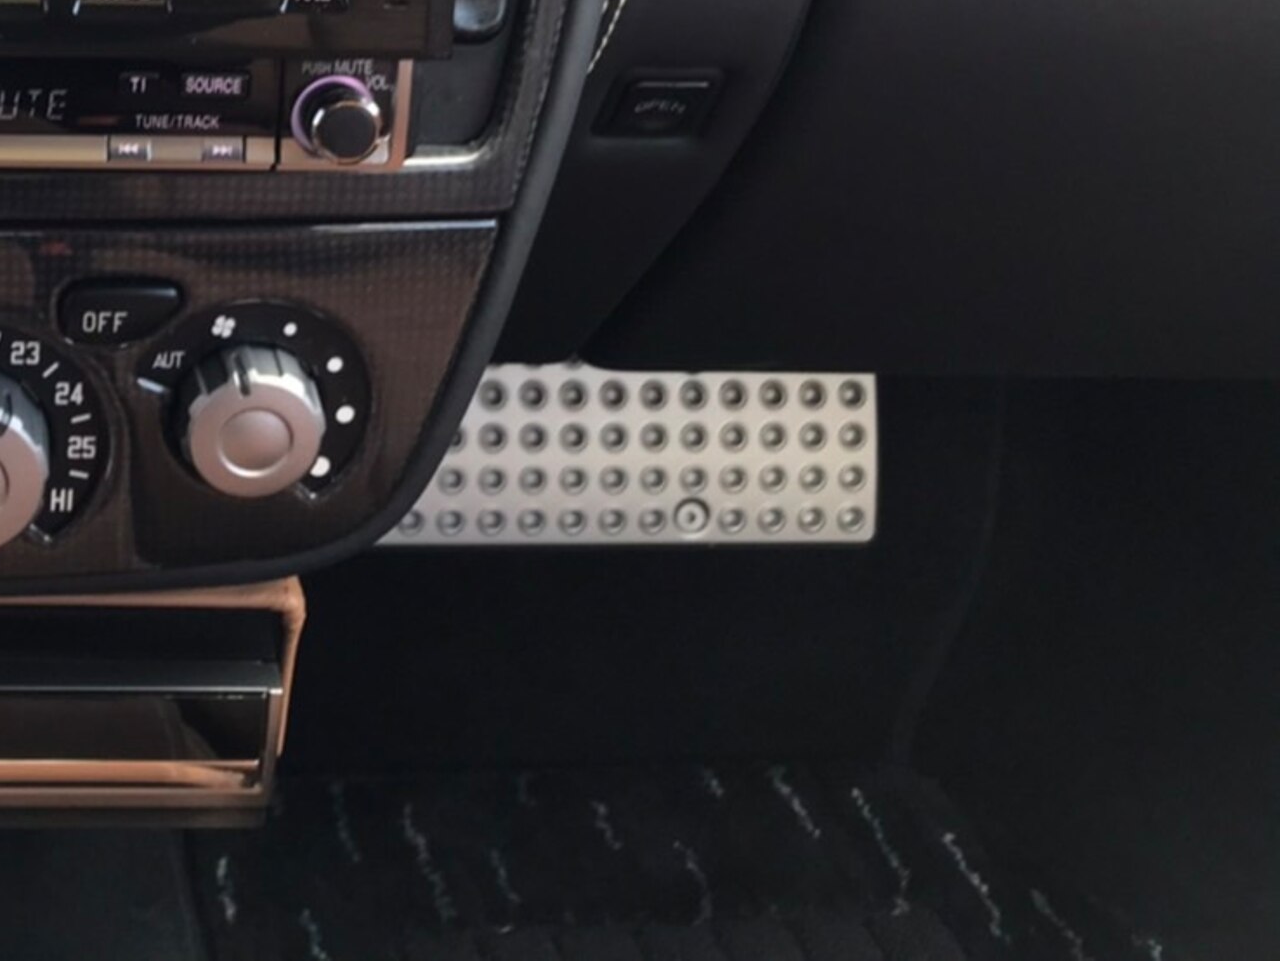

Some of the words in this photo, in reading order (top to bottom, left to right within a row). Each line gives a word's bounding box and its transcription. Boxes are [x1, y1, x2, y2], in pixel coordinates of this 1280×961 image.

[334, 59, 373, 75] MUTE
[186, 76, 242, 94] SOURCE
[135, 114, 221, 130] TUNE/TRACK
[82, 311, 127, 334] OFF
[10, 342, 40, 366] 23
[55, 382, 84, 406] 24
[67, 436, 96, 460] 25
[50, 488, 73, 513] HI
